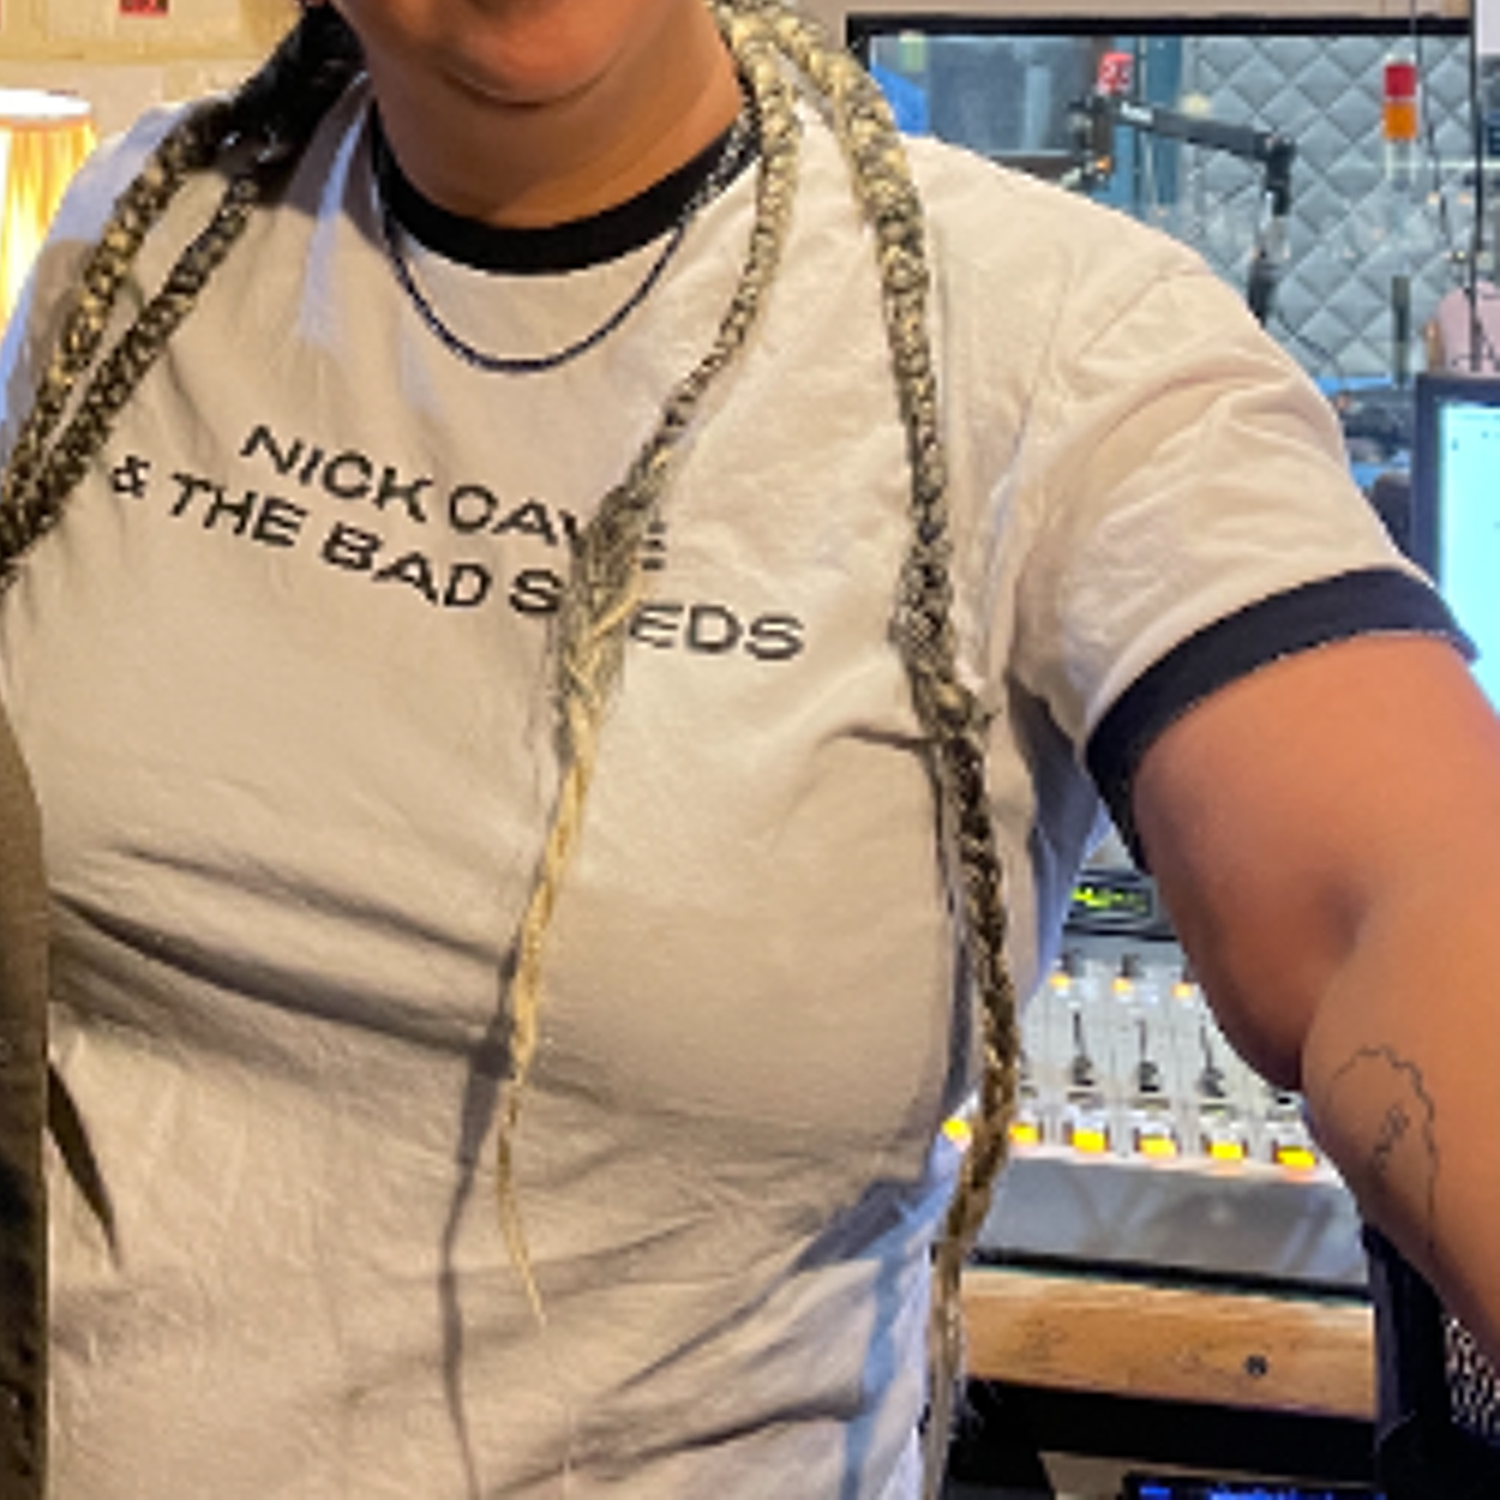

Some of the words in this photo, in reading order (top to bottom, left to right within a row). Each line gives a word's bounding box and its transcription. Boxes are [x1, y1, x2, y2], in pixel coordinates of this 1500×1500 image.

[241, 425, 434, 522] NICK
[111, 456, 151, 497] &
[170, 473, 308, 547] THE
[321, 523, 493, 608] BAD
[509, 568, 806, 660] SEDS
